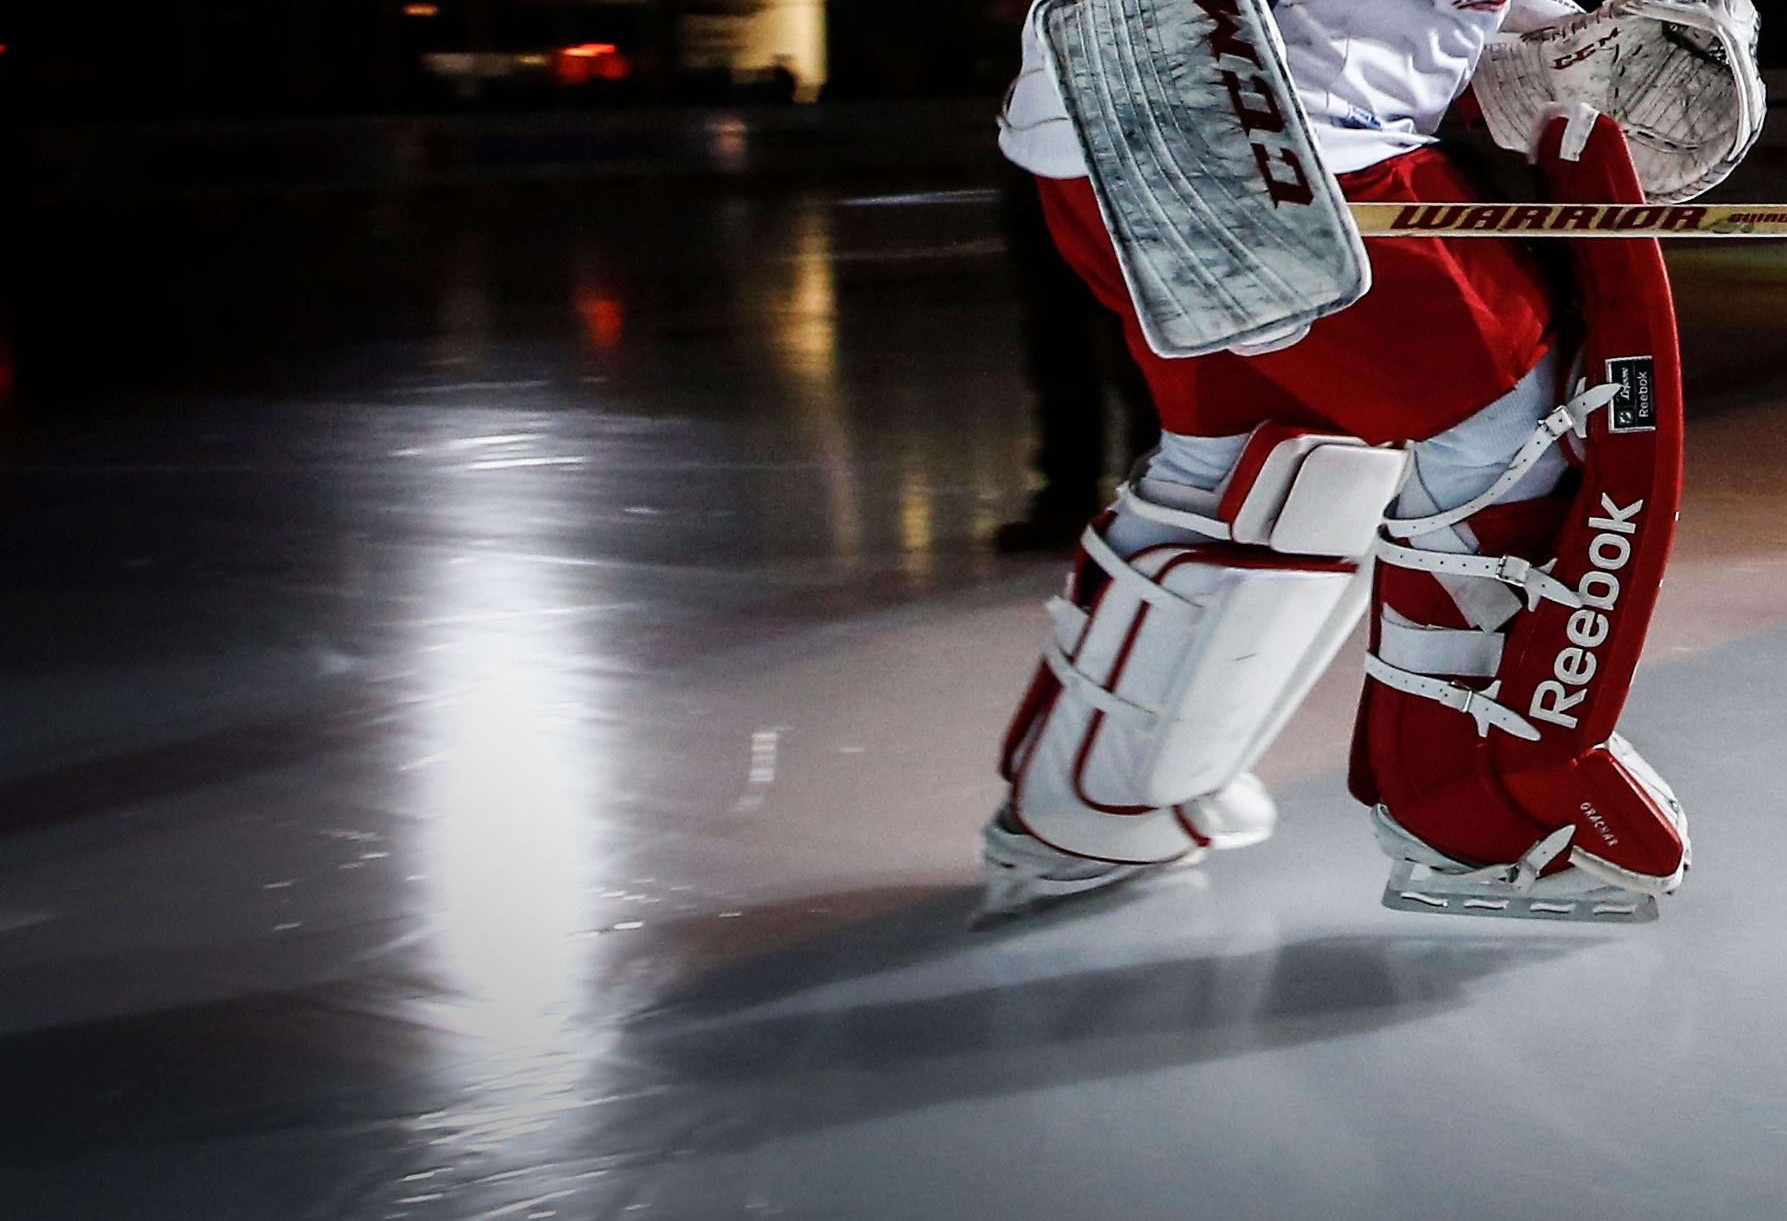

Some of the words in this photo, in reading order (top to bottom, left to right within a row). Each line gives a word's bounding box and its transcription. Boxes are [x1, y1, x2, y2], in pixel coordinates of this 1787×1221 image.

[1389, 205, 1707, 231] WARRIOR
[1637, 370, 1649, 418] Reebok
[1528, 492, 1644, 729] Reebok
